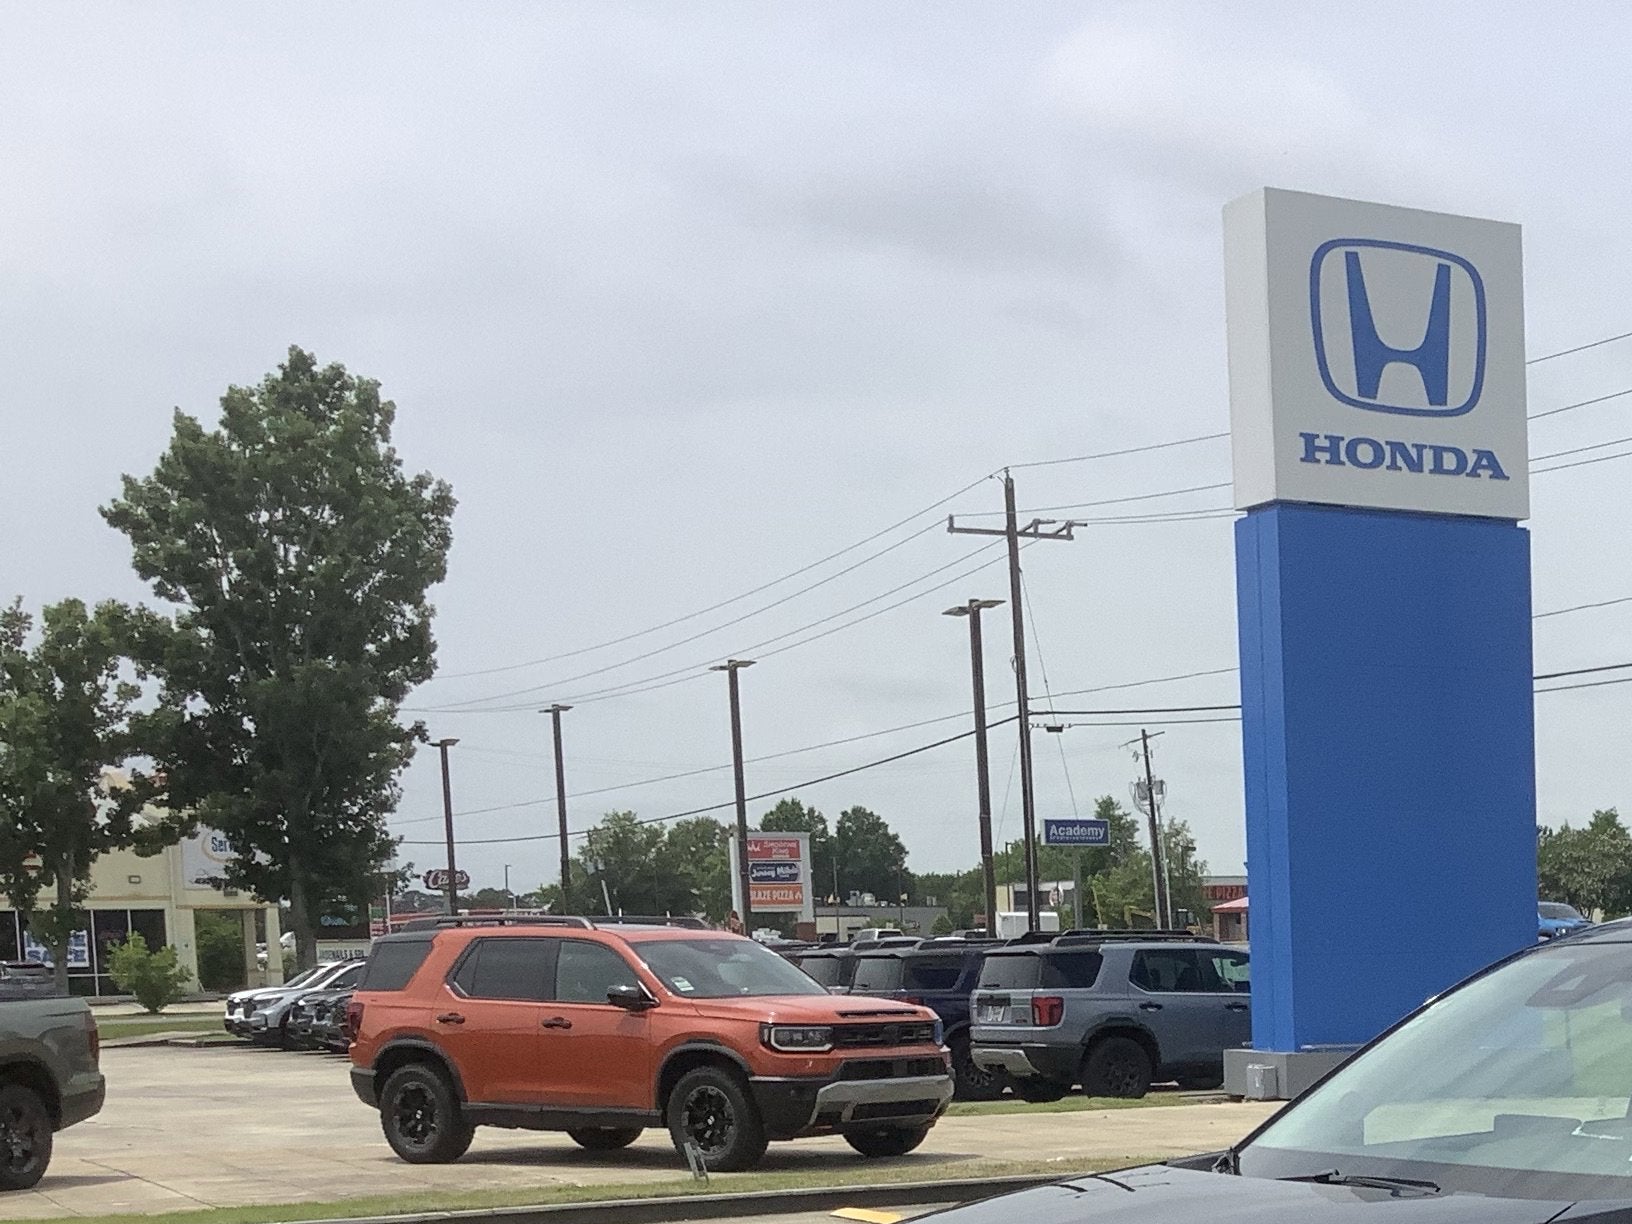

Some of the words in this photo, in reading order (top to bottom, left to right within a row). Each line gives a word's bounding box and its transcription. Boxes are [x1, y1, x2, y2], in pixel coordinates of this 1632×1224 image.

[1299, 432, 1510, 481] HONDA
[1050, 824, 1105, 840] Academy
[773, 890, 795, 901] PIZZA
